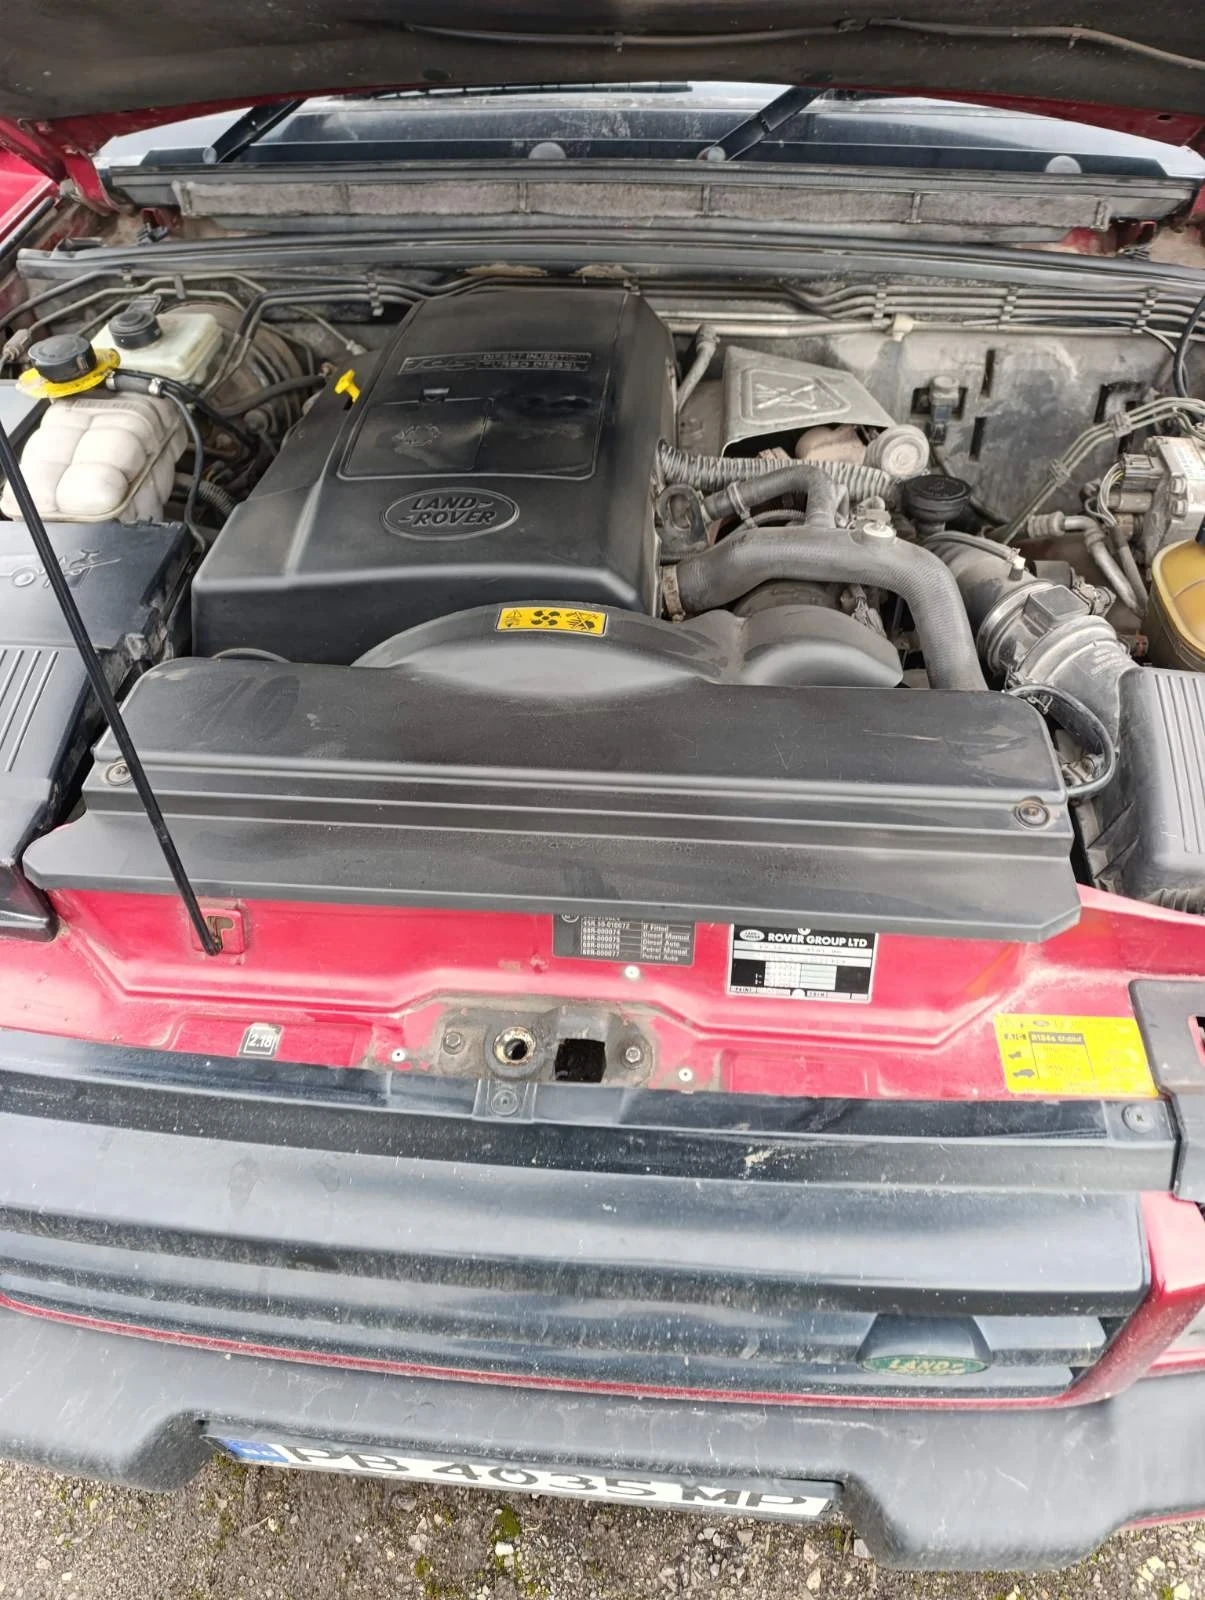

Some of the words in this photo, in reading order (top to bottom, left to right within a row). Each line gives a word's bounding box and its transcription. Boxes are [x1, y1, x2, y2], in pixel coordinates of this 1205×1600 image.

[413, 511, 497, 526] ROVER
[664, 932, 690, 940] Manual
[767, 932, 805, 944] ROVER
[806, 934, 847, 947] GROUP
[848, 938, 868, 948] LTD
[433, 1462, 657, 1496] 4035
